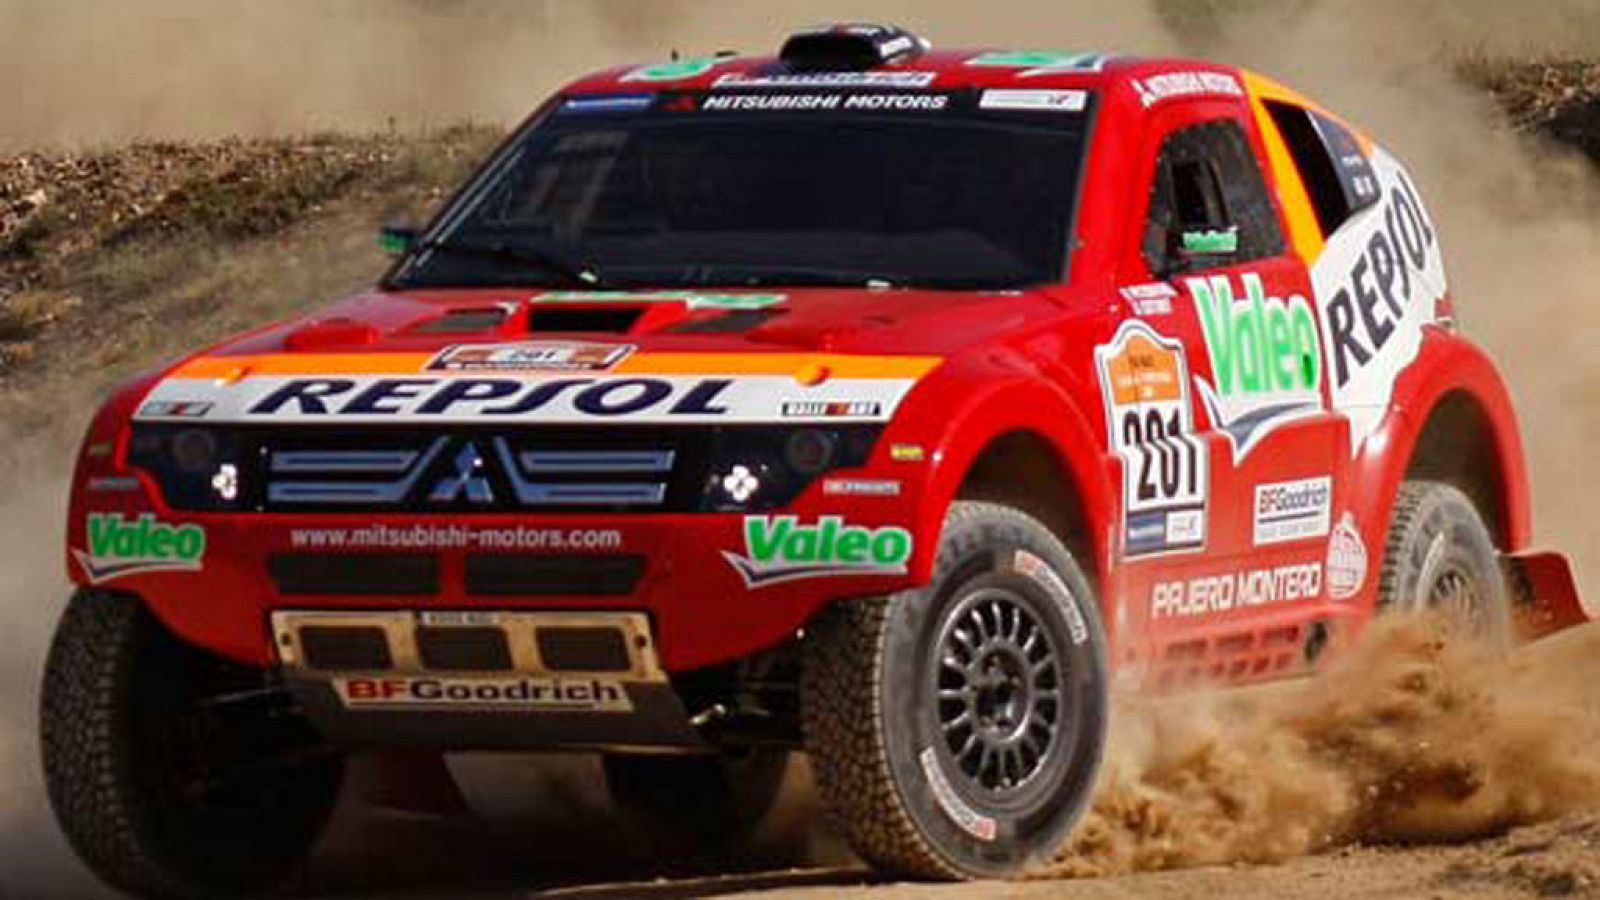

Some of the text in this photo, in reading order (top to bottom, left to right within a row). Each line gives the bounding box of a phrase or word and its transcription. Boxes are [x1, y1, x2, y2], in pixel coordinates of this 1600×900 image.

[703, 94, 948, 110] MITSUBISHI MOTORS
[1327, 170, 1432, 388] REPSOL
[1189, 274, 1320, 394] Valeo
[249, 378, 734, 416] REPSOL
[1123, 408, 1198, 500] 201
[1258, 483, 1327, 513] BFGoodrich
[86, 514, 206, 563] Valeo
[290, 525, 622, 548] www.mitsubishi-motors.com
[743, 515, 913, 568] Valeo
[1152, 574, 1234, 619] PAJERO
[1237, 562, 1322, 607] MONTERO
[346, 679, 620, 701] BFGoodrich
